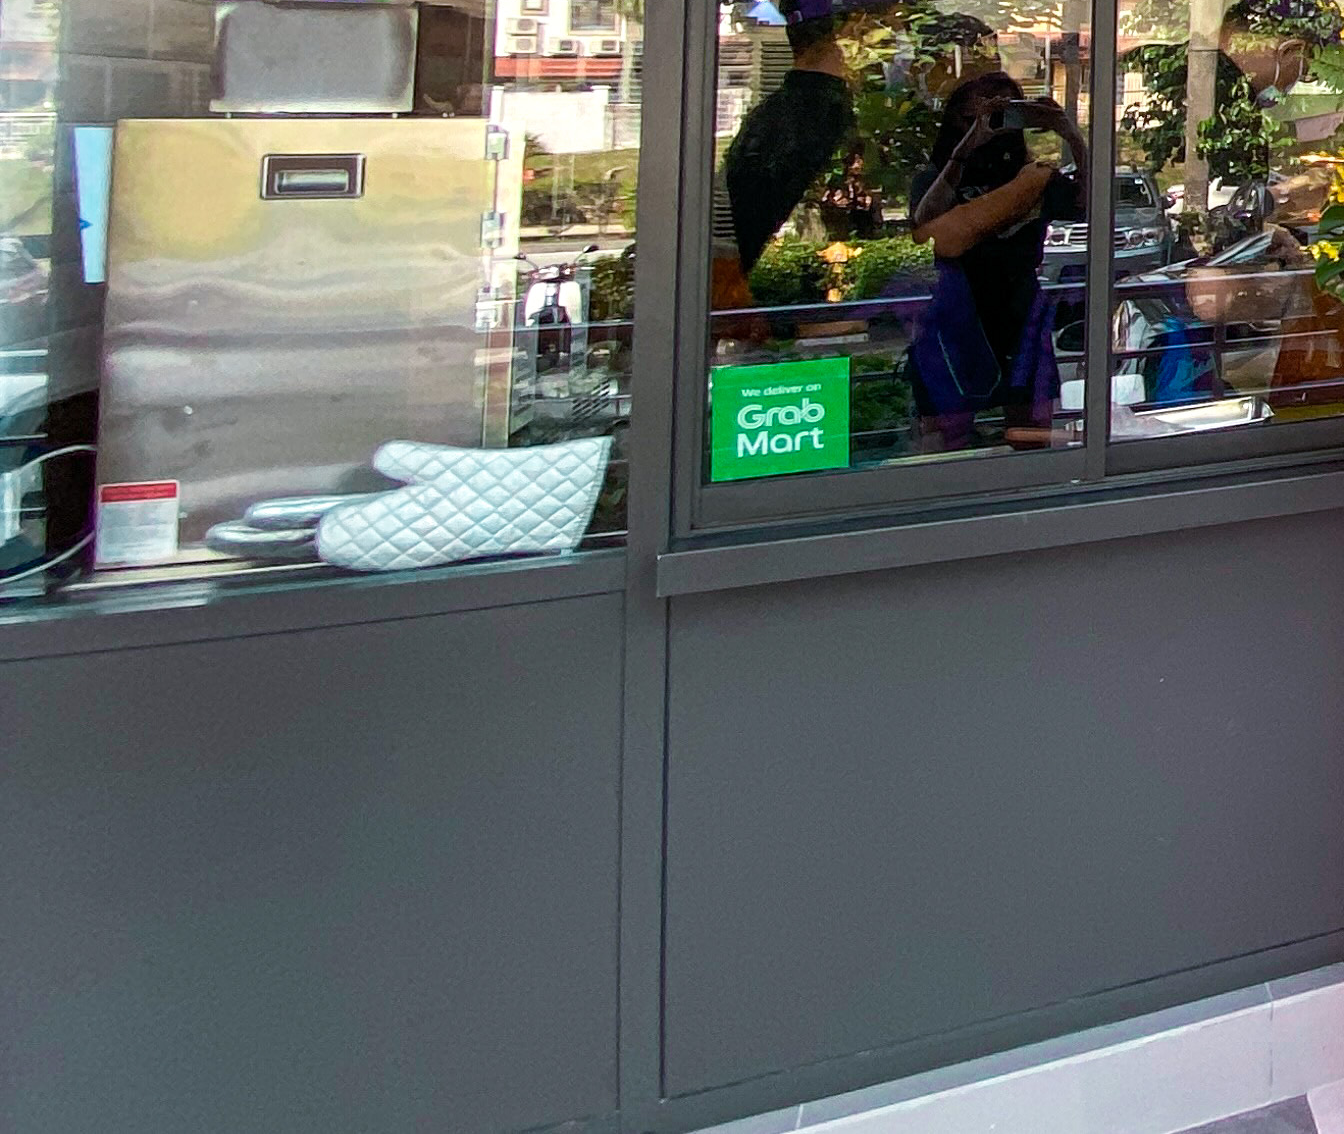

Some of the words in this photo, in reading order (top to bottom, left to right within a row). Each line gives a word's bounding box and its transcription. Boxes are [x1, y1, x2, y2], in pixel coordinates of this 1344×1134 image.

[741, 388, 761, 398] We
[763, 384, 802, 397] deliver
[806, 383, 822, 393] on
[737, 397, 826, 430] Grab
[737, 426, 825, 458] Mart
